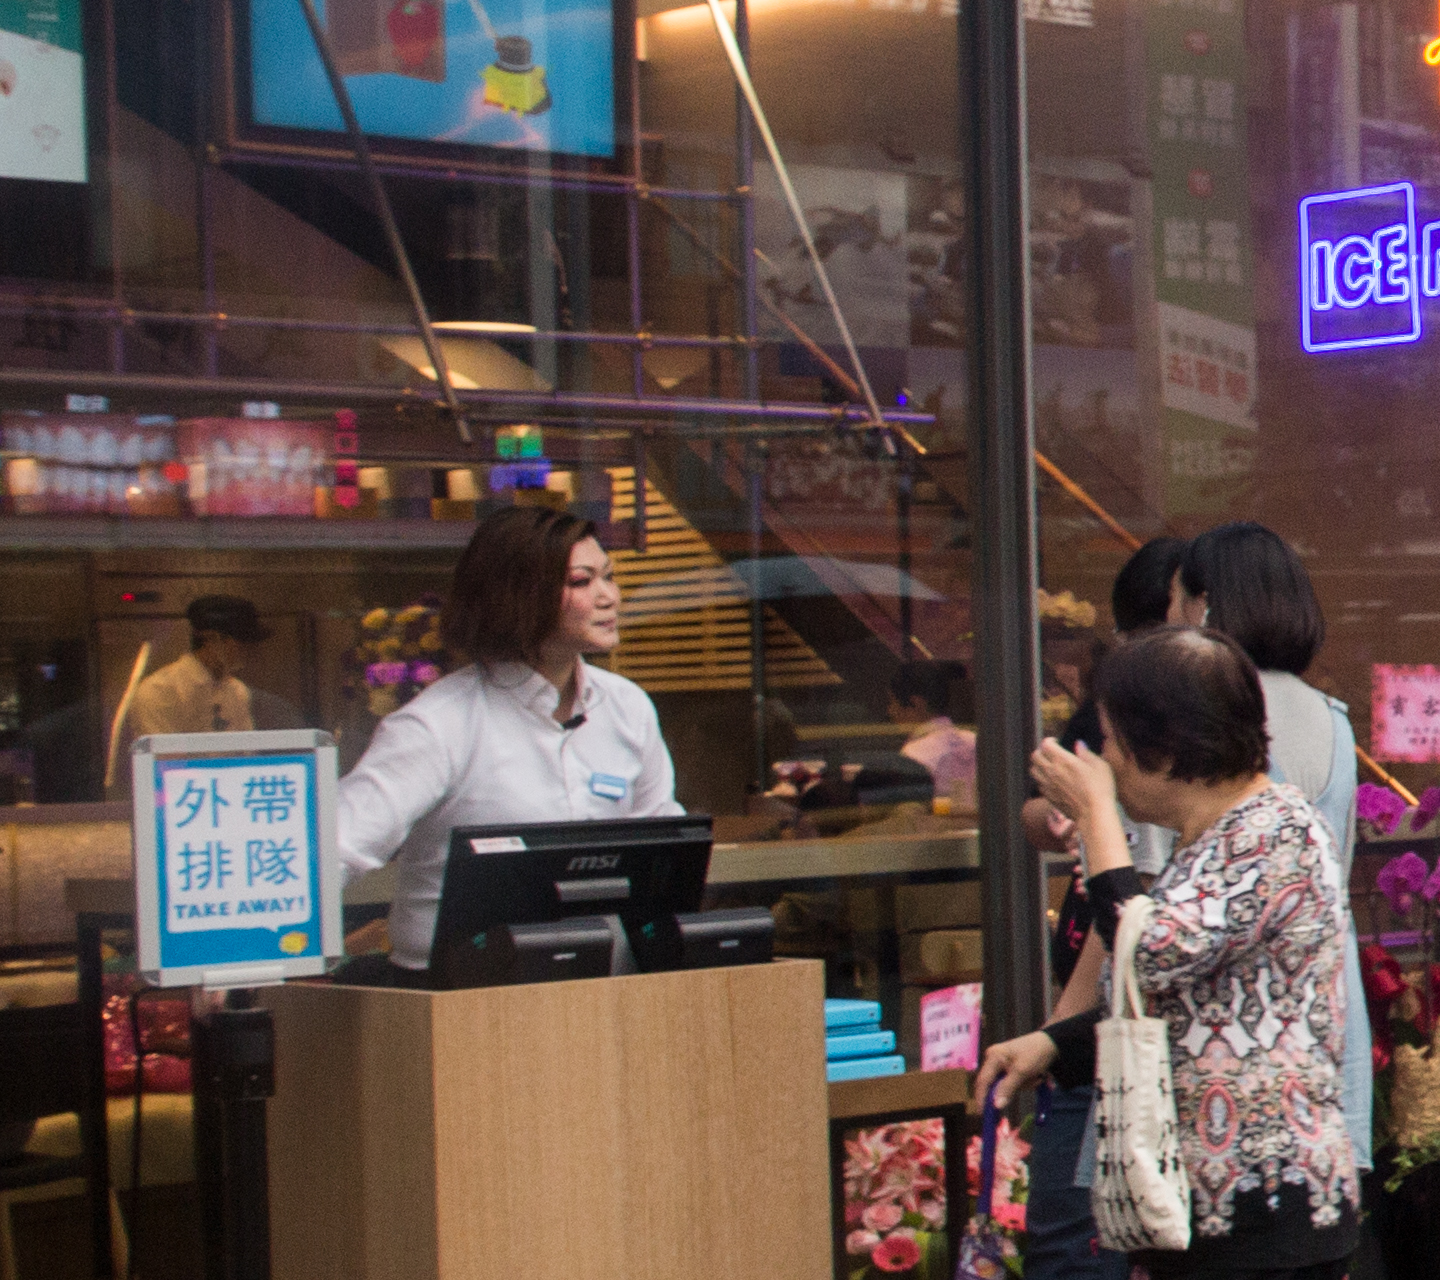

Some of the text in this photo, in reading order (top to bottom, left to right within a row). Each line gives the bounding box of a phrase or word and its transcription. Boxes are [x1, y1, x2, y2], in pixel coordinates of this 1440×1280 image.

[1310, 224, 1410, 311] ICE
[175, 775, 297, 828] 外帶
[177, 836, 300, 892] 排隊
[568, 854, 621, 870] msi
[174, 895, 305, 919] TAKE AWAY!
